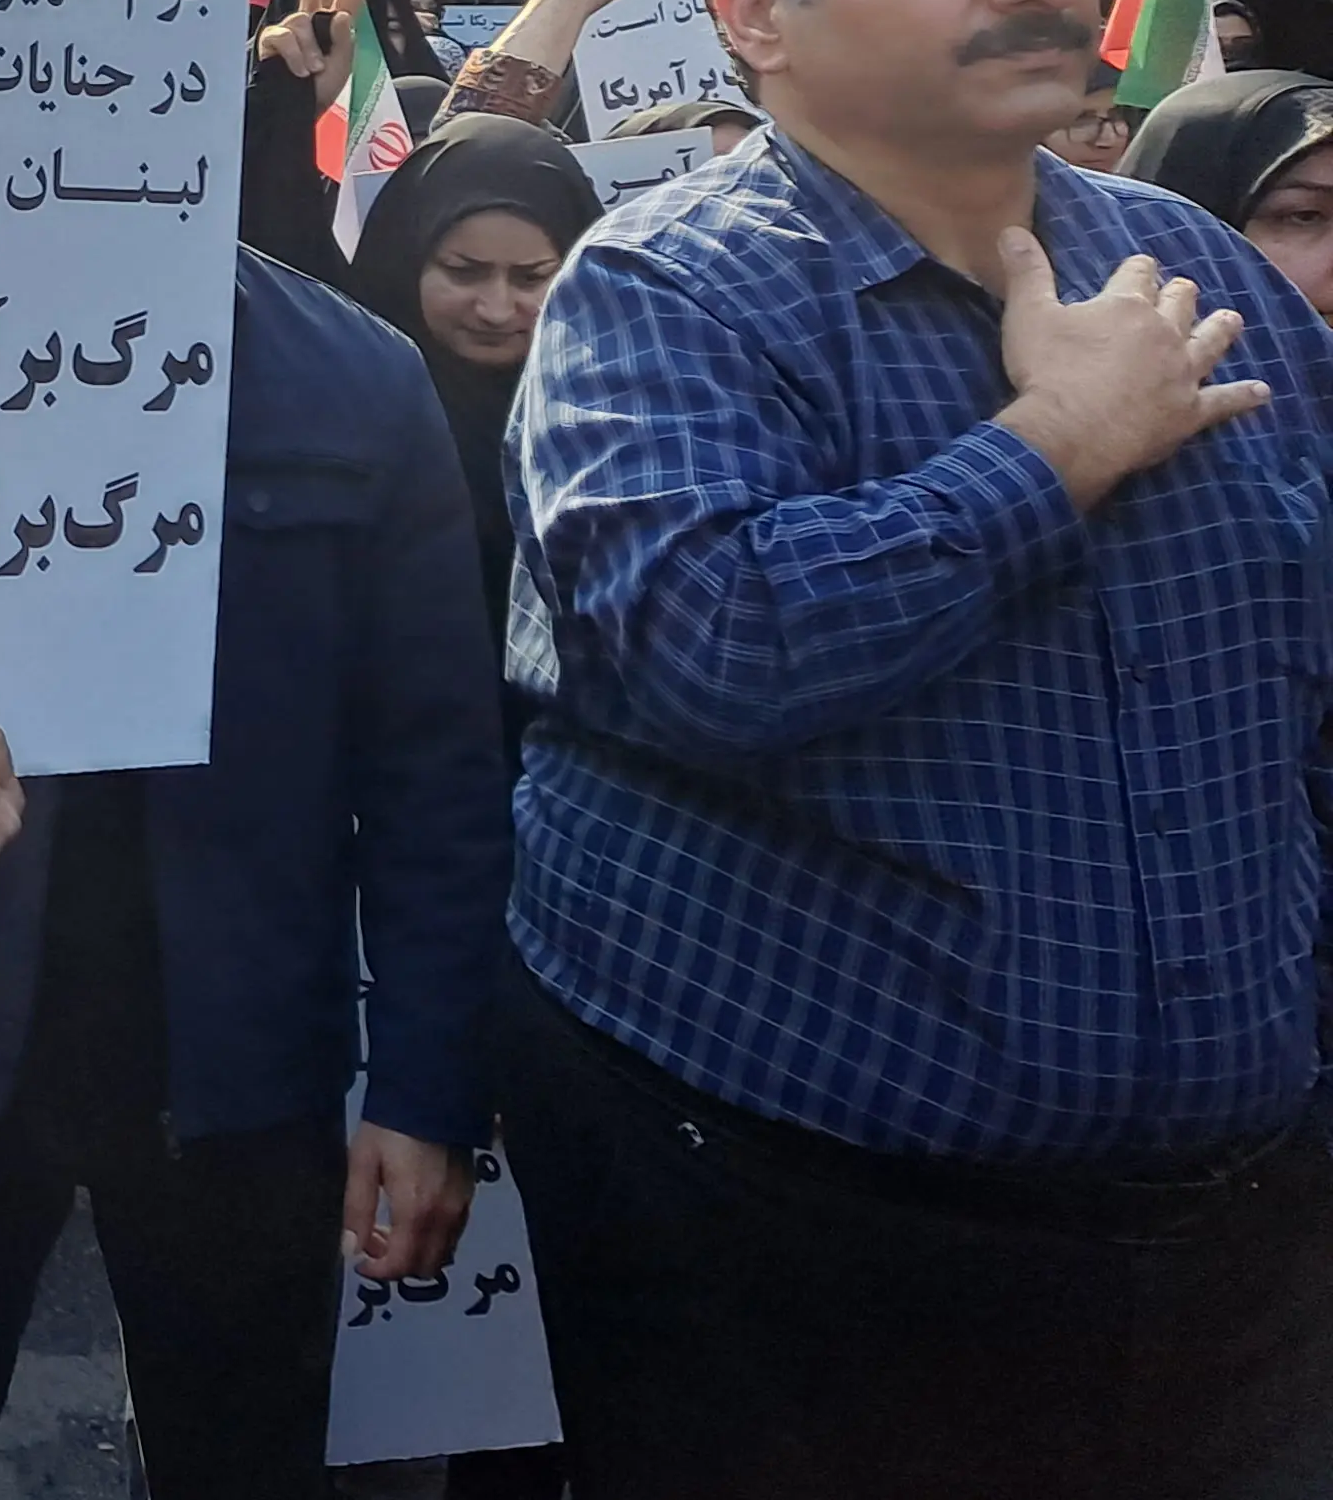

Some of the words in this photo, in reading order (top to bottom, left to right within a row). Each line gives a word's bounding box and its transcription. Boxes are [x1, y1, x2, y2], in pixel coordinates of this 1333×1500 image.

[150, 60, 207, 114] در
[5, 147, 209, 223] لبنان
[0, 331, 62, 411] بر
[72, 311, 214, 412] مرگ
[64, 472, 204, 574] مرگ
